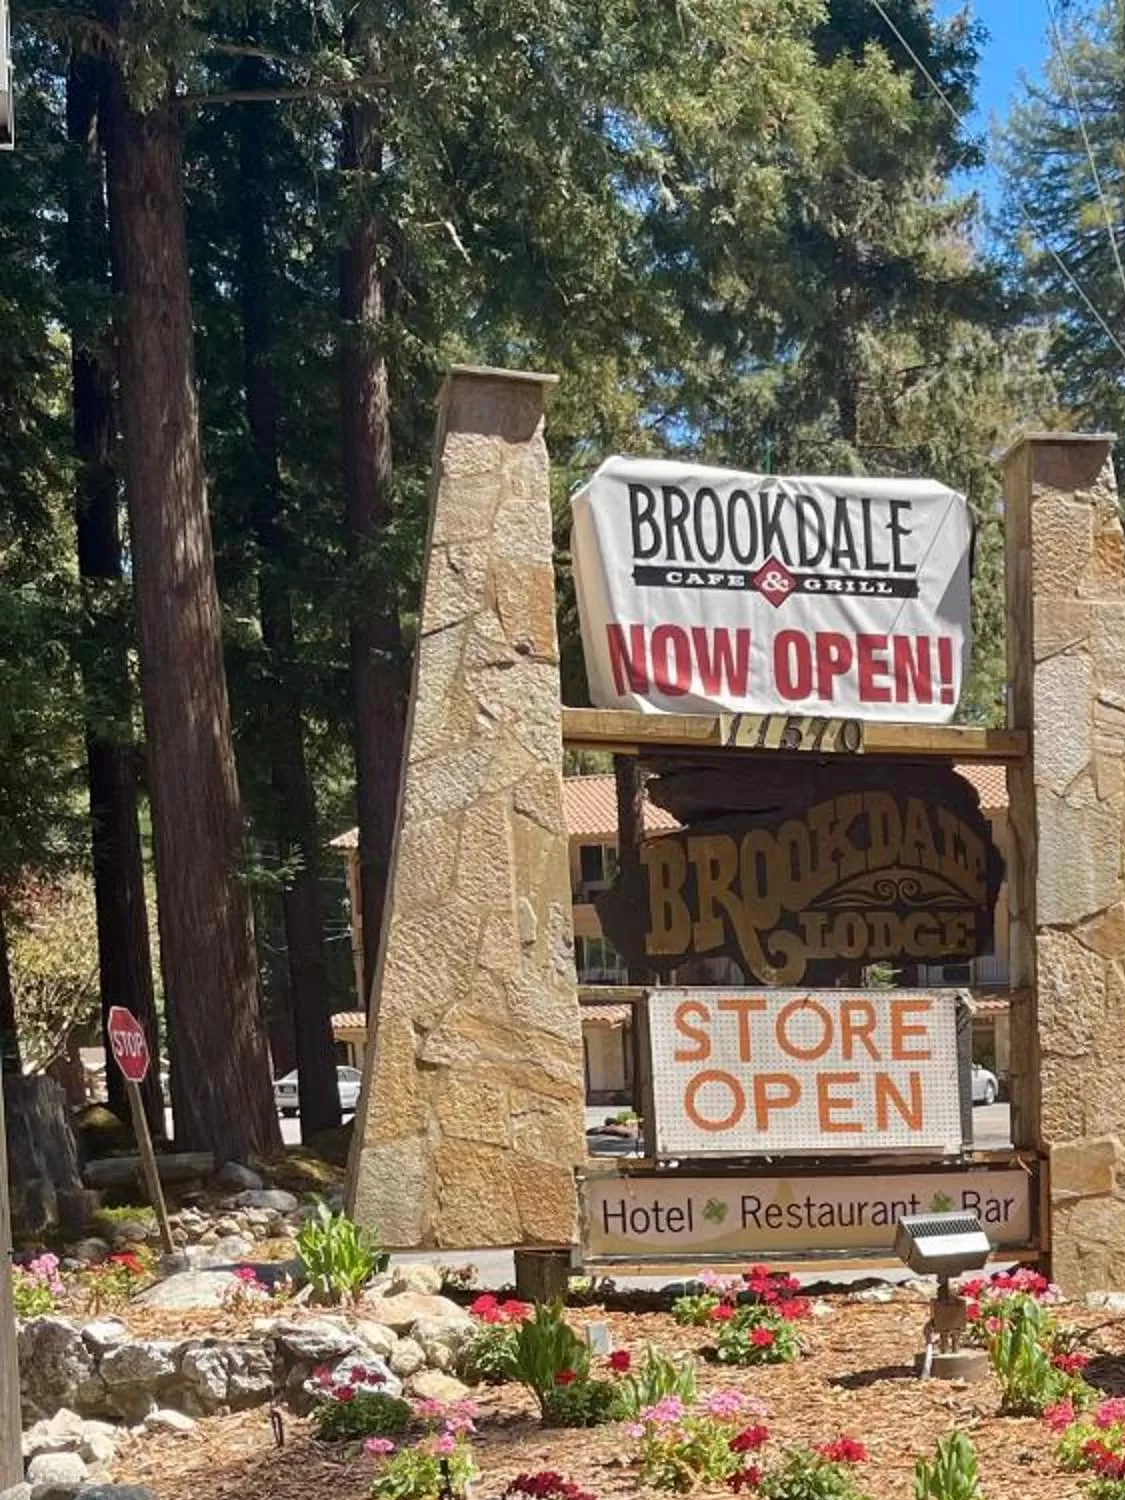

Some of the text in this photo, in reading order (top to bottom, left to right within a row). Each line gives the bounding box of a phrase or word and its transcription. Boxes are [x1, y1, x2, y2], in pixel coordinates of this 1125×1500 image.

[628, 483, 917, 573] BROOKDALE
[665, 570, 894, 594] CAFE & GRILL
[606, 623, 954, 705] NOW OPEN!
[640, 790, 987, 986] BROOKDALE
[800, 911, 976, 960] LODGE
[113, 1031, 144, 1058] STOP
[673, 998, 931, 1063] STORE
[684, 1068, 924, 1133] OPEN
[602, 1190, 1015, 1235] Hotel Restaurant Bar
